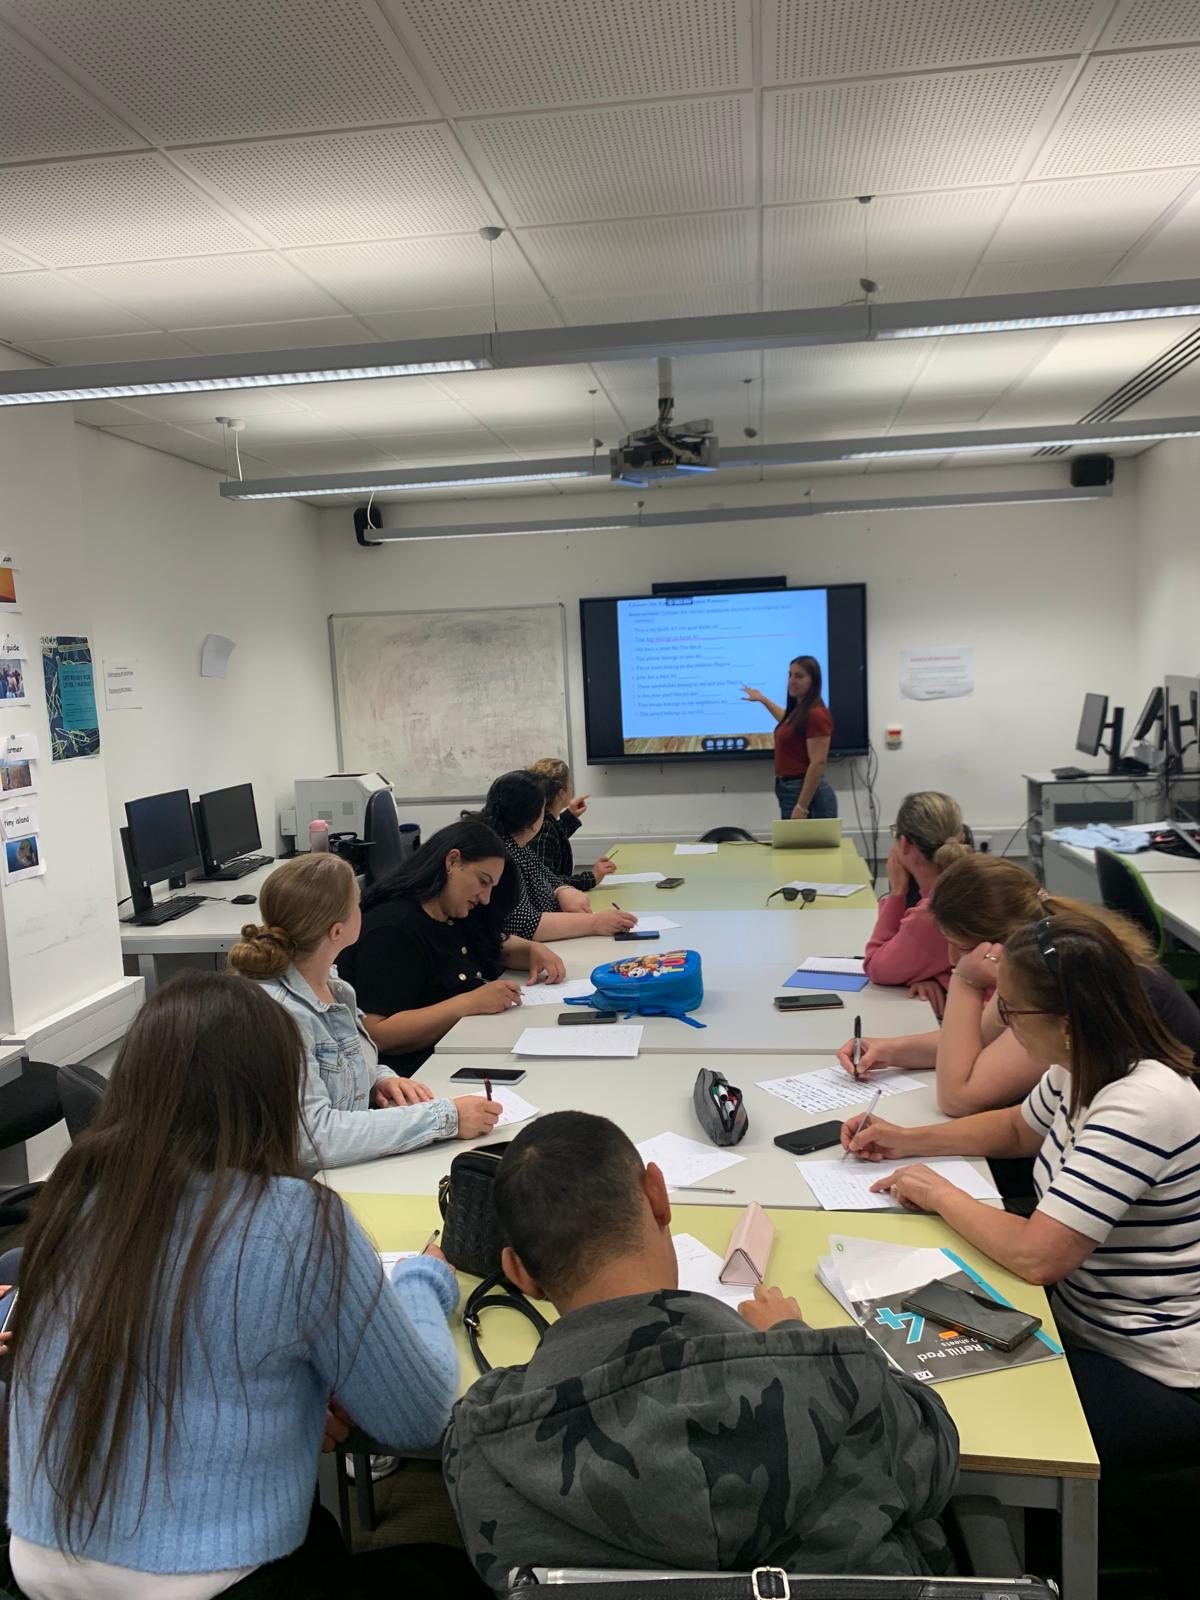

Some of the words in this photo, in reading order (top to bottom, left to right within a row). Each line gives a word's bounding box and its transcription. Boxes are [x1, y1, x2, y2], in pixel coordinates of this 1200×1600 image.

[7, 643, 20, 653] guide
[7, 746, 23, 754] armer
[16, 816, 30, 825] island
[875, 1307, 925, 1344] 4
[941, 1338, 969, 1348] sheets
[944, 1343, 985, 1358] Refill
[916, 1350, 947, 1363] Pad
